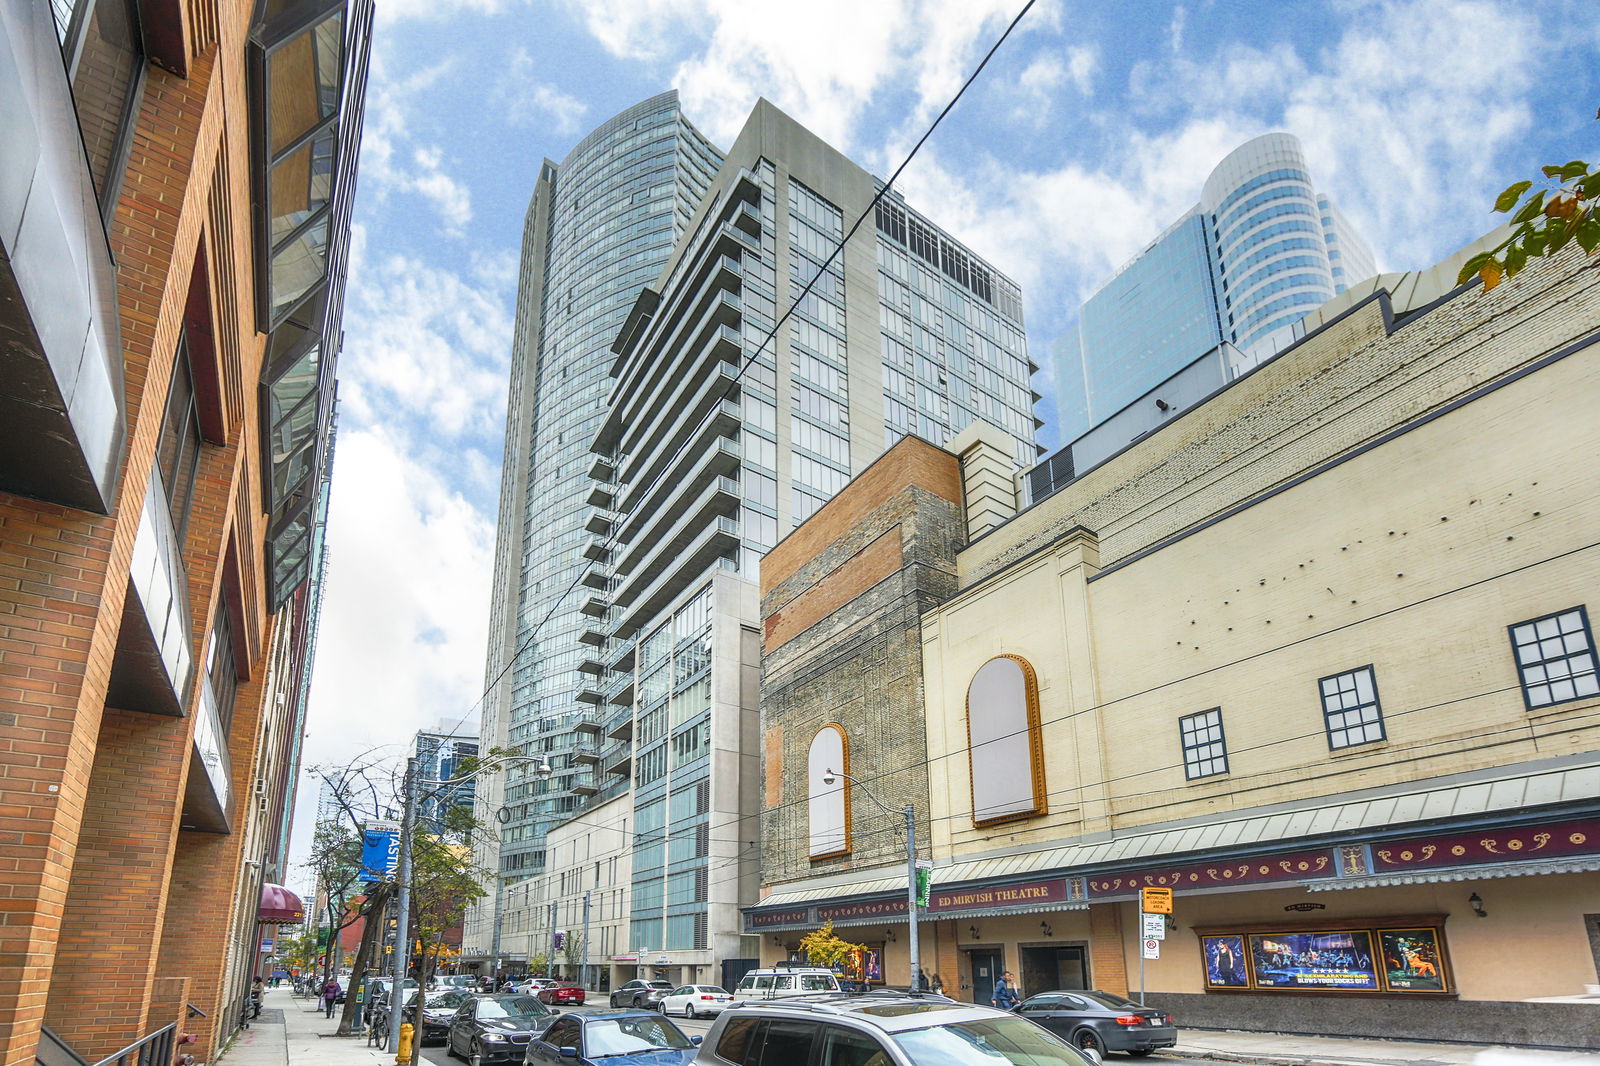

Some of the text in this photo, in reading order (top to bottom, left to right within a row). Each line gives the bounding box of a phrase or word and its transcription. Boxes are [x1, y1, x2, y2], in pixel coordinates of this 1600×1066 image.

[385, 831, 401, 882] TASTING
[938, 886, 1048, 907] ED MIRVISH THEATRE
